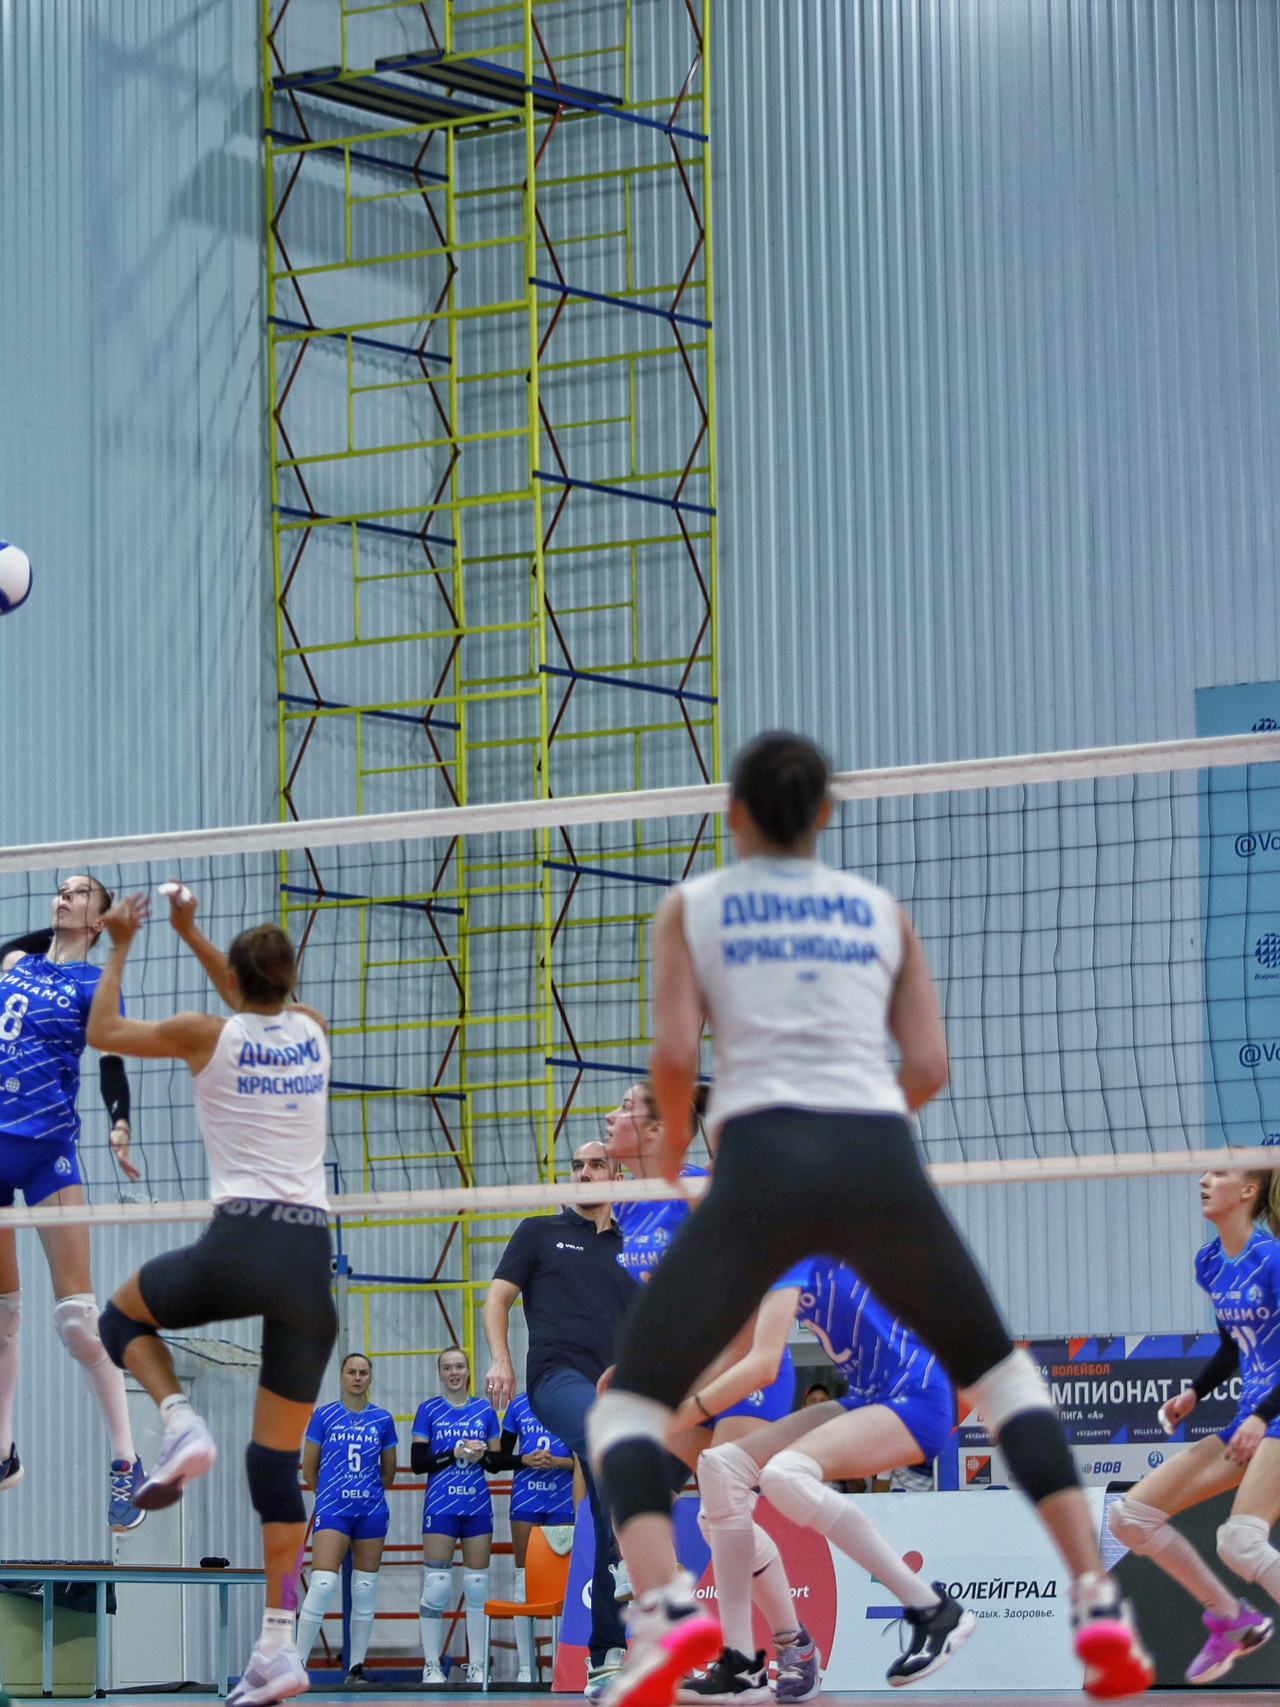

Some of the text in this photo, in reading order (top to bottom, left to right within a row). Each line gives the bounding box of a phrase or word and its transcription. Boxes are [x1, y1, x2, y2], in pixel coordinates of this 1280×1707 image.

[1051, 1363, 1110, 1376] ВОЛЕЙБОЛ
[1051, 1379, 1172, 1404] МПИОНАТ
[1061, 1411, 1083, 1420] ЛИГА
[329, 1432, 380, 1445] ДИНАМО
[436, 1429, 484, 1440] ДИНАМО
[347, 1443, 361, 1472] 5
[1093, 1461, 1122, 1474] ВФВ
[425, 1516, 432, 1528] 3
[939, 1578, 1057, 1600] ВОЛЕЙГРАД
[1003, 1609, 1055, 1620] Здоровье.
